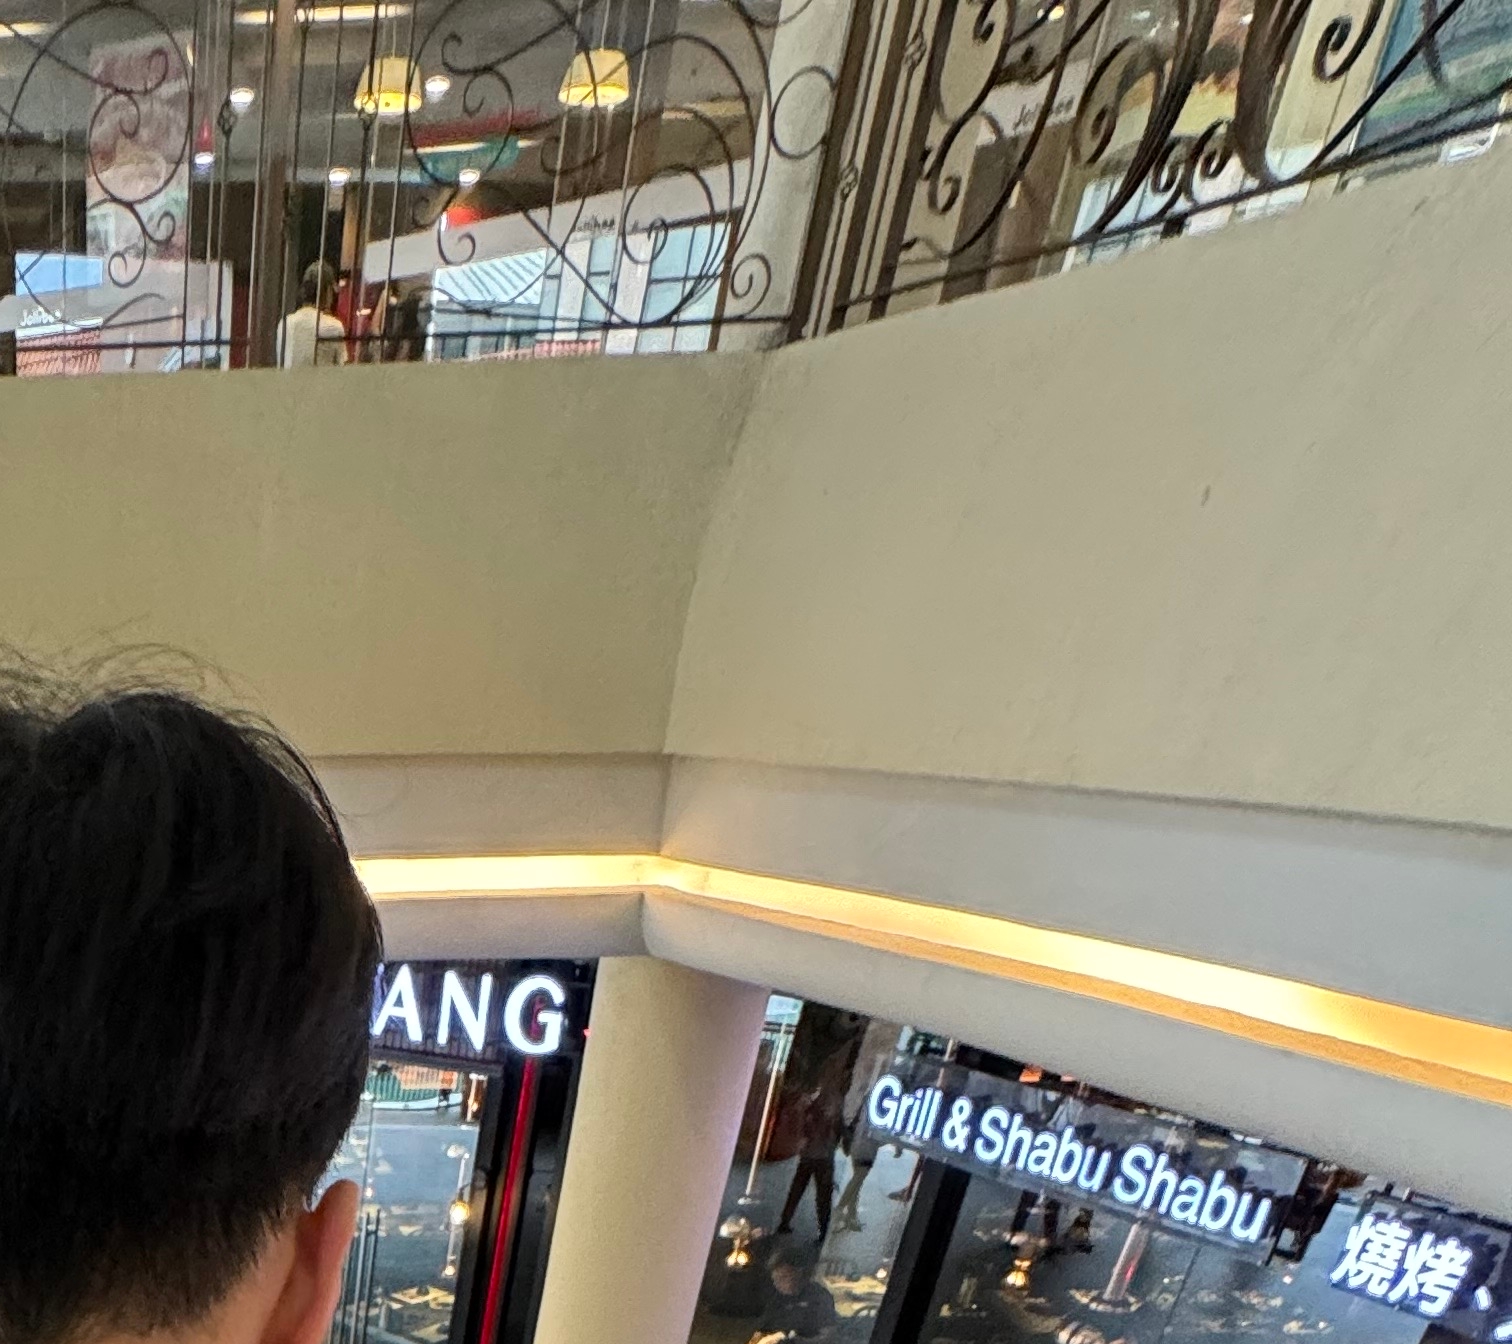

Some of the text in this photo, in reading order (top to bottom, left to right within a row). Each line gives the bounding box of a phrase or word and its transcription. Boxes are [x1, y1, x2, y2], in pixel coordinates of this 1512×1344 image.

[372, 962, 567, 1056] ANG
[867, 1074, 1273, 1243] Grill & Shabu Shabu
